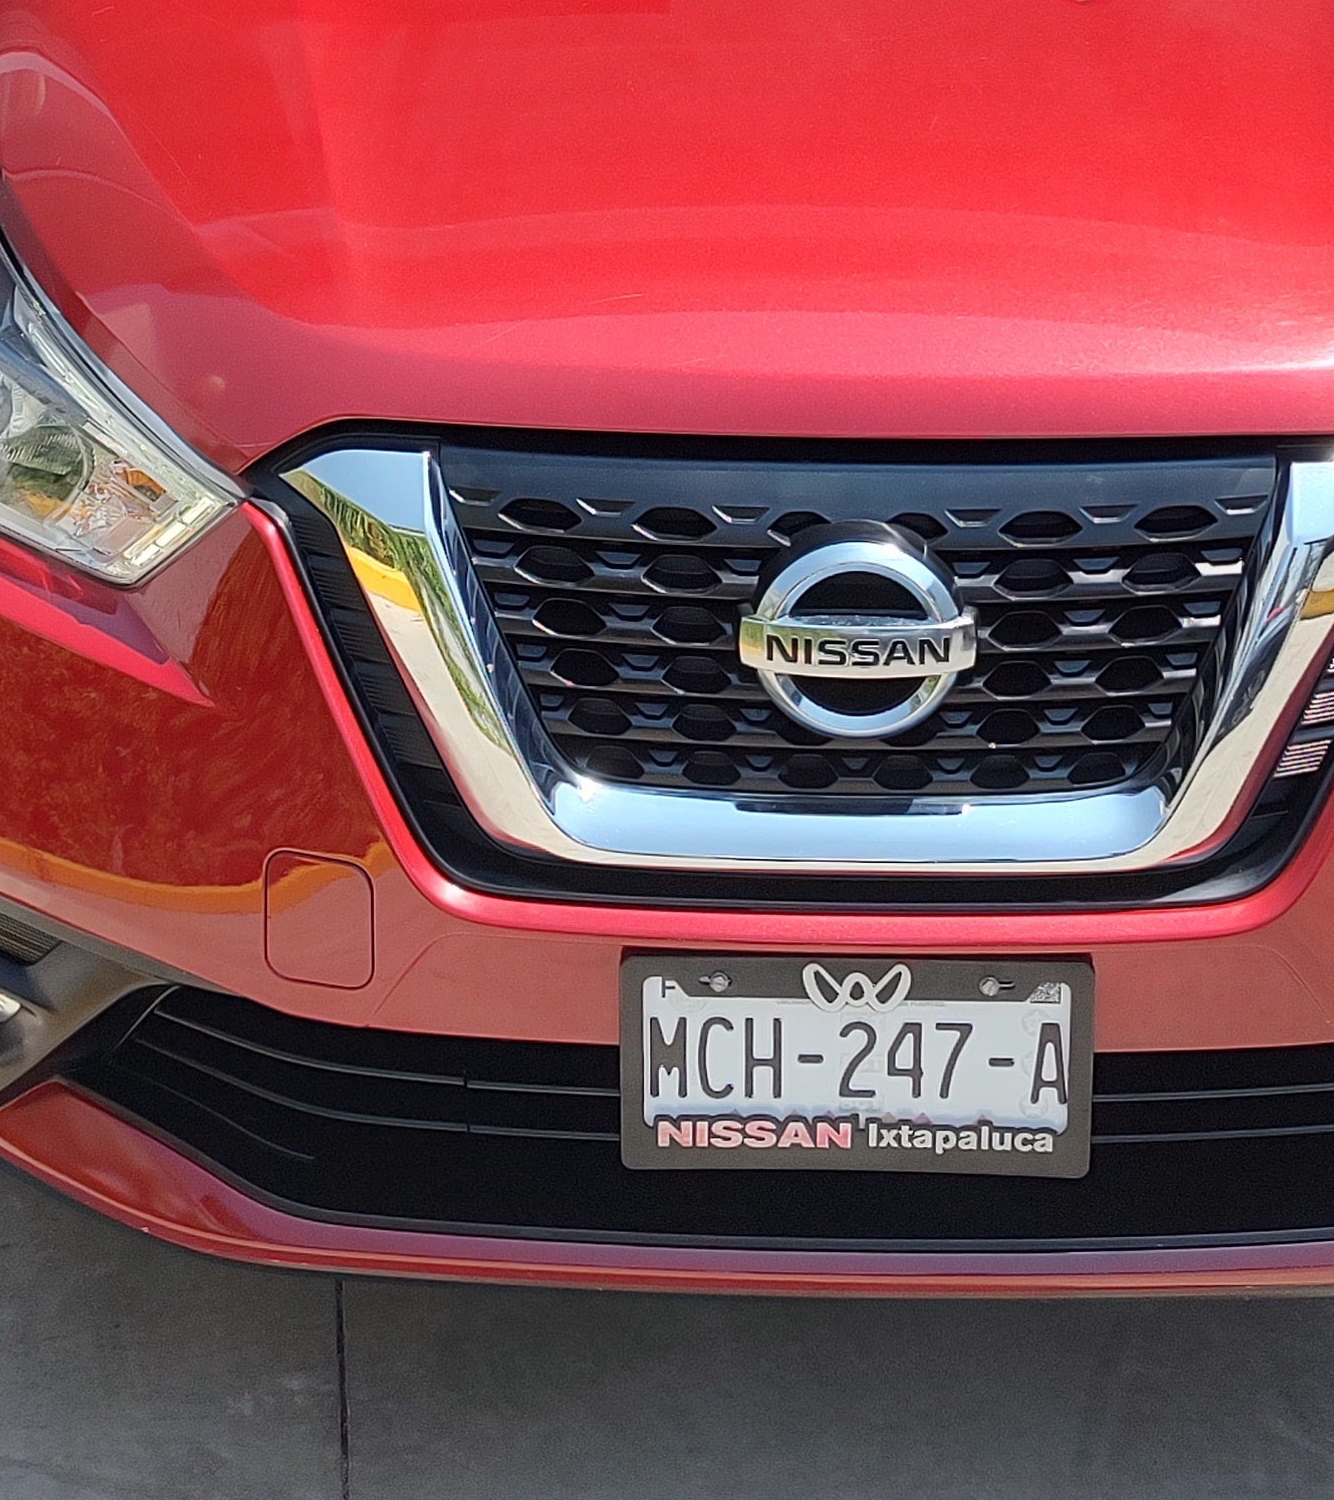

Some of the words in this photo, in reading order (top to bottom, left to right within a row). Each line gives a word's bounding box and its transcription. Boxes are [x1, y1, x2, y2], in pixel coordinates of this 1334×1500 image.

[765, 634, 952, 667] NISSAN
[649, 1015, 1068, 1105] MCH-247-A
[657, 1120, 852, 1149] NISSAN
[868, 1122, 1054, 1155] Ixtapaluca
